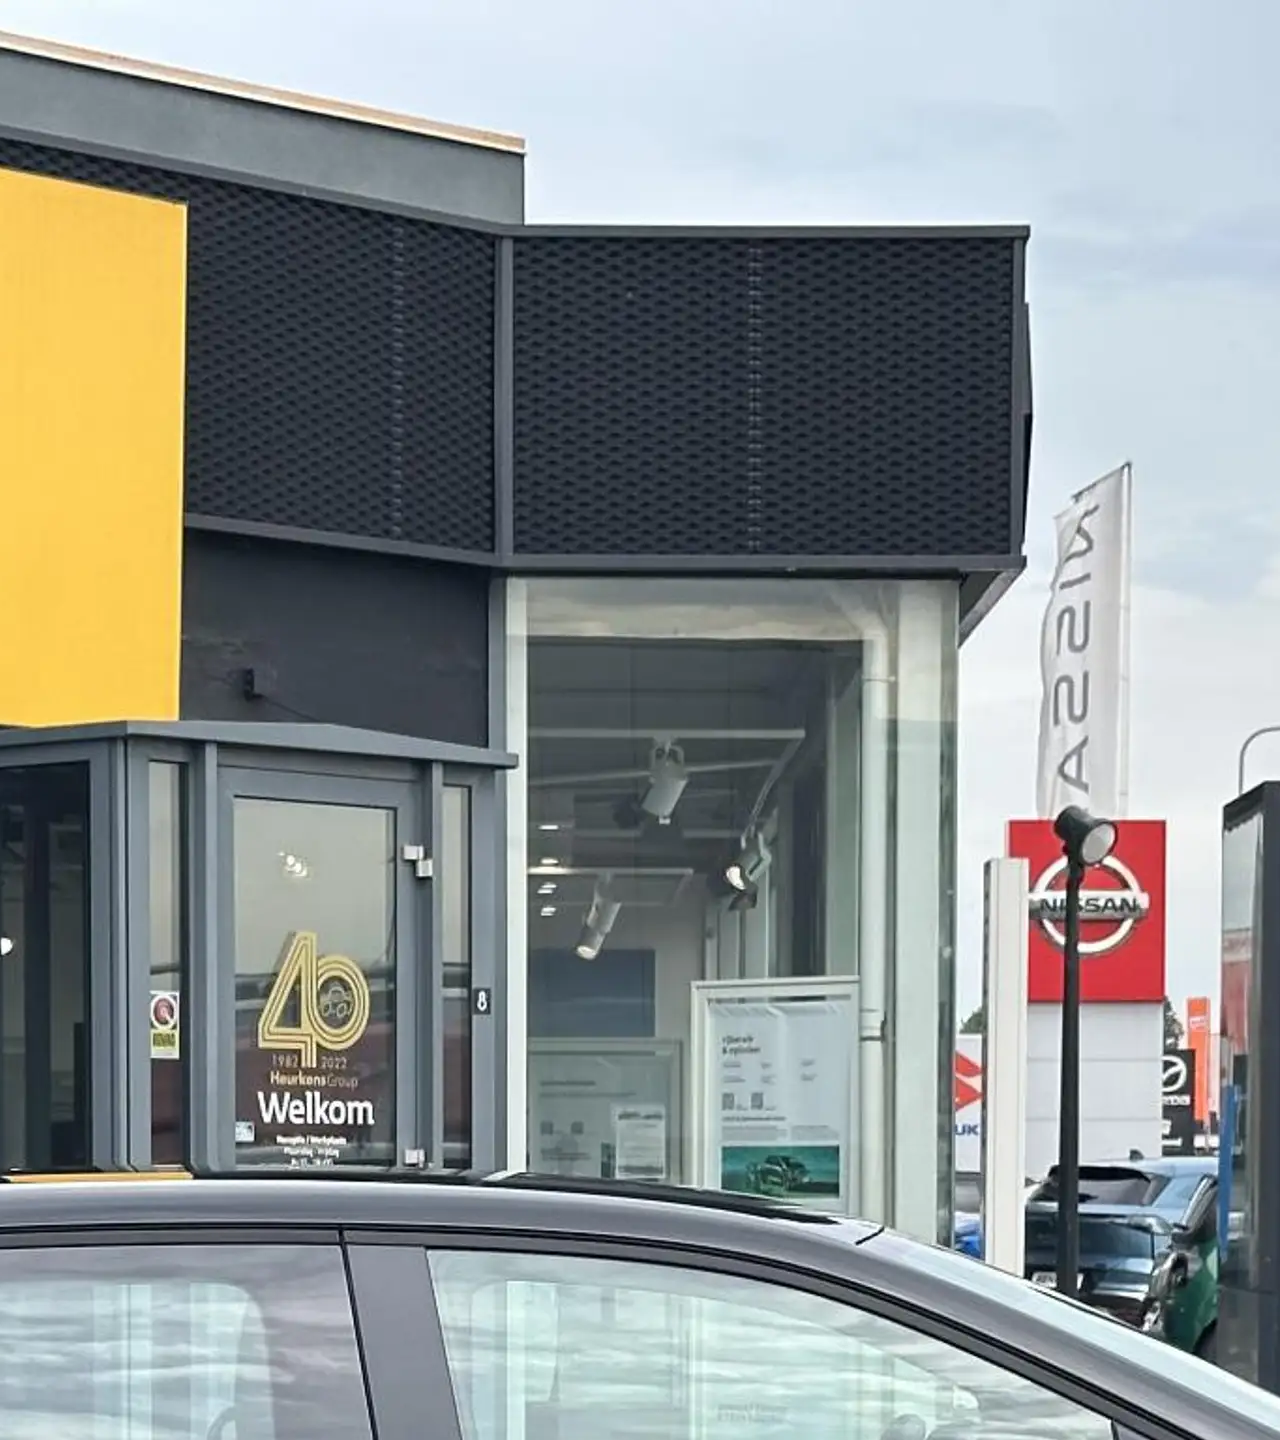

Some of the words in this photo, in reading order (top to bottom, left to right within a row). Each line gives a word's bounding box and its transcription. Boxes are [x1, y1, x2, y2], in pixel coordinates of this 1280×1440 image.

[1040, 897, 1138, 913] NISAN
[257, 930, 370, 1068] 40
[476, 990, 488, 1011] 8
[257, 1091, 376, 1125] Welkom
